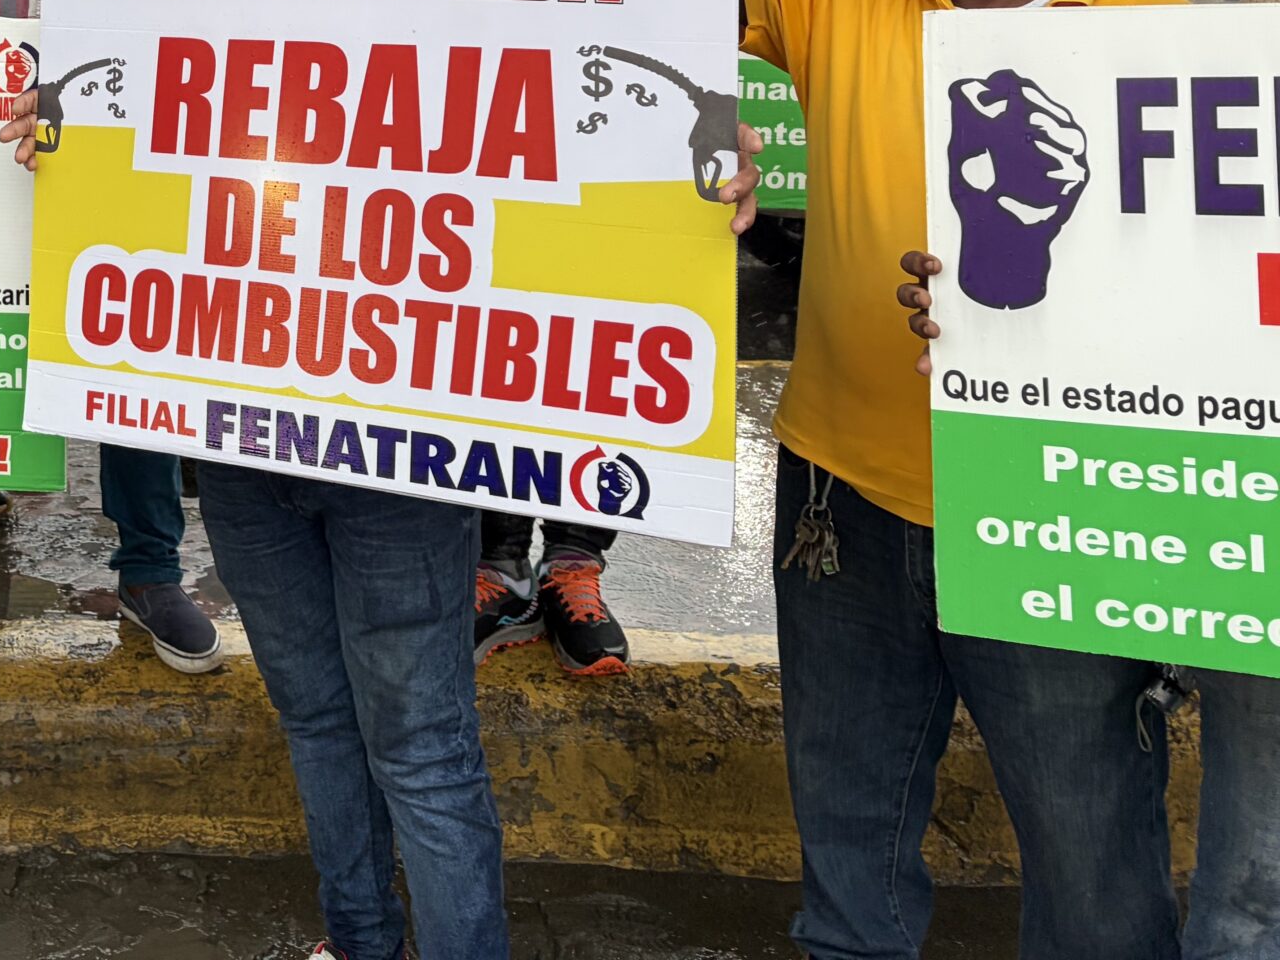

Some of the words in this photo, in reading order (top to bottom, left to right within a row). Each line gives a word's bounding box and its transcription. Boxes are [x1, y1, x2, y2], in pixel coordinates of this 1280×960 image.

[149, 35, 559, 182] REBAJA
[1116, 76, 1280, 217] FE
[203, 176, 300, 275] DE
[319, 185, 475, 293] LOS
[80, 262, 693, 426] COMBUSTIBLES
[941, 369, 1009, 404] Que
[1021, 378, 1050, 408] el
[1062, 382, 1184, 417] estado
[1198, 395, 1280, 430] pagu
[85, 390, 197, 438] FILIAL
[205, 399, 560, 507] FENATRAN
[976, 515, 1187, 565] ordene
[1209, 533, 1266, 573] el
[1021, 584, 1074, 621] el
